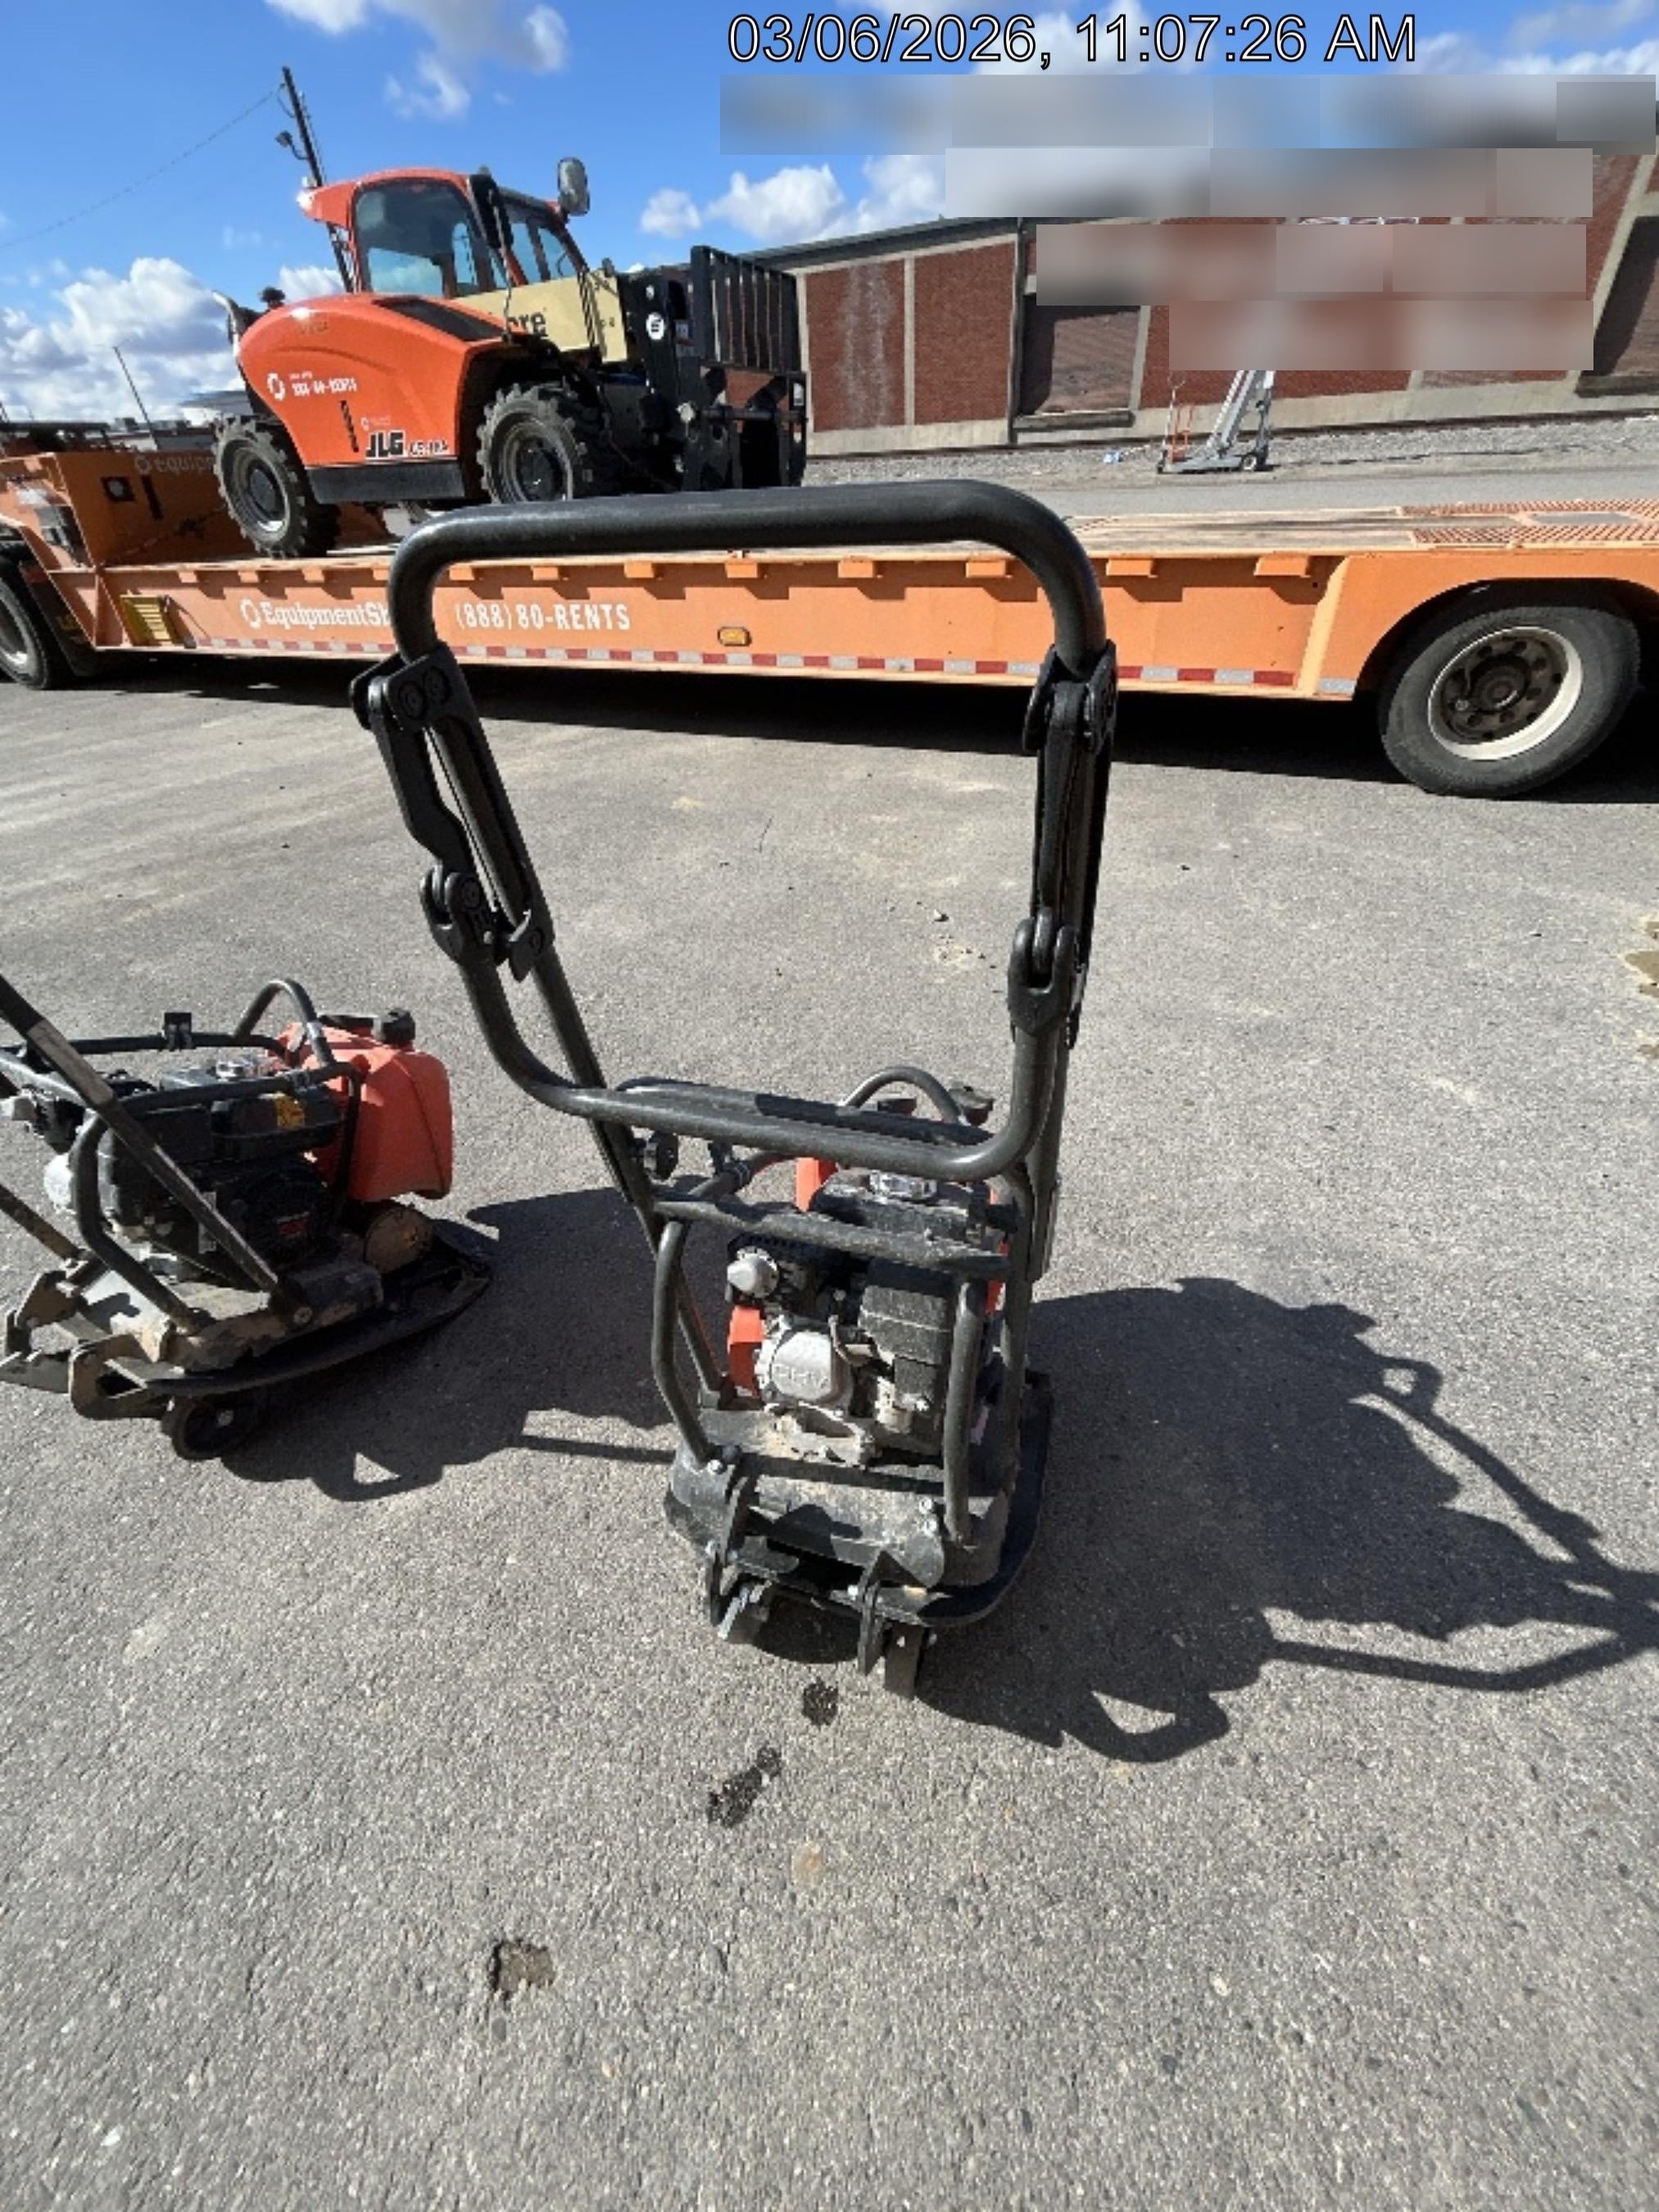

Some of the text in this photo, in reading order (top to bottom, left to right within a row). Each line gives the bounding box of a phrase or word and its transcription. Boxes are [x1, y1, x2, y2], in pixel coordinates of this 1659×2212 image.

[365, 431, 406, 459] JLG
[260, 601, 631, 631] EquipmentSh (888) 80-RENTS
